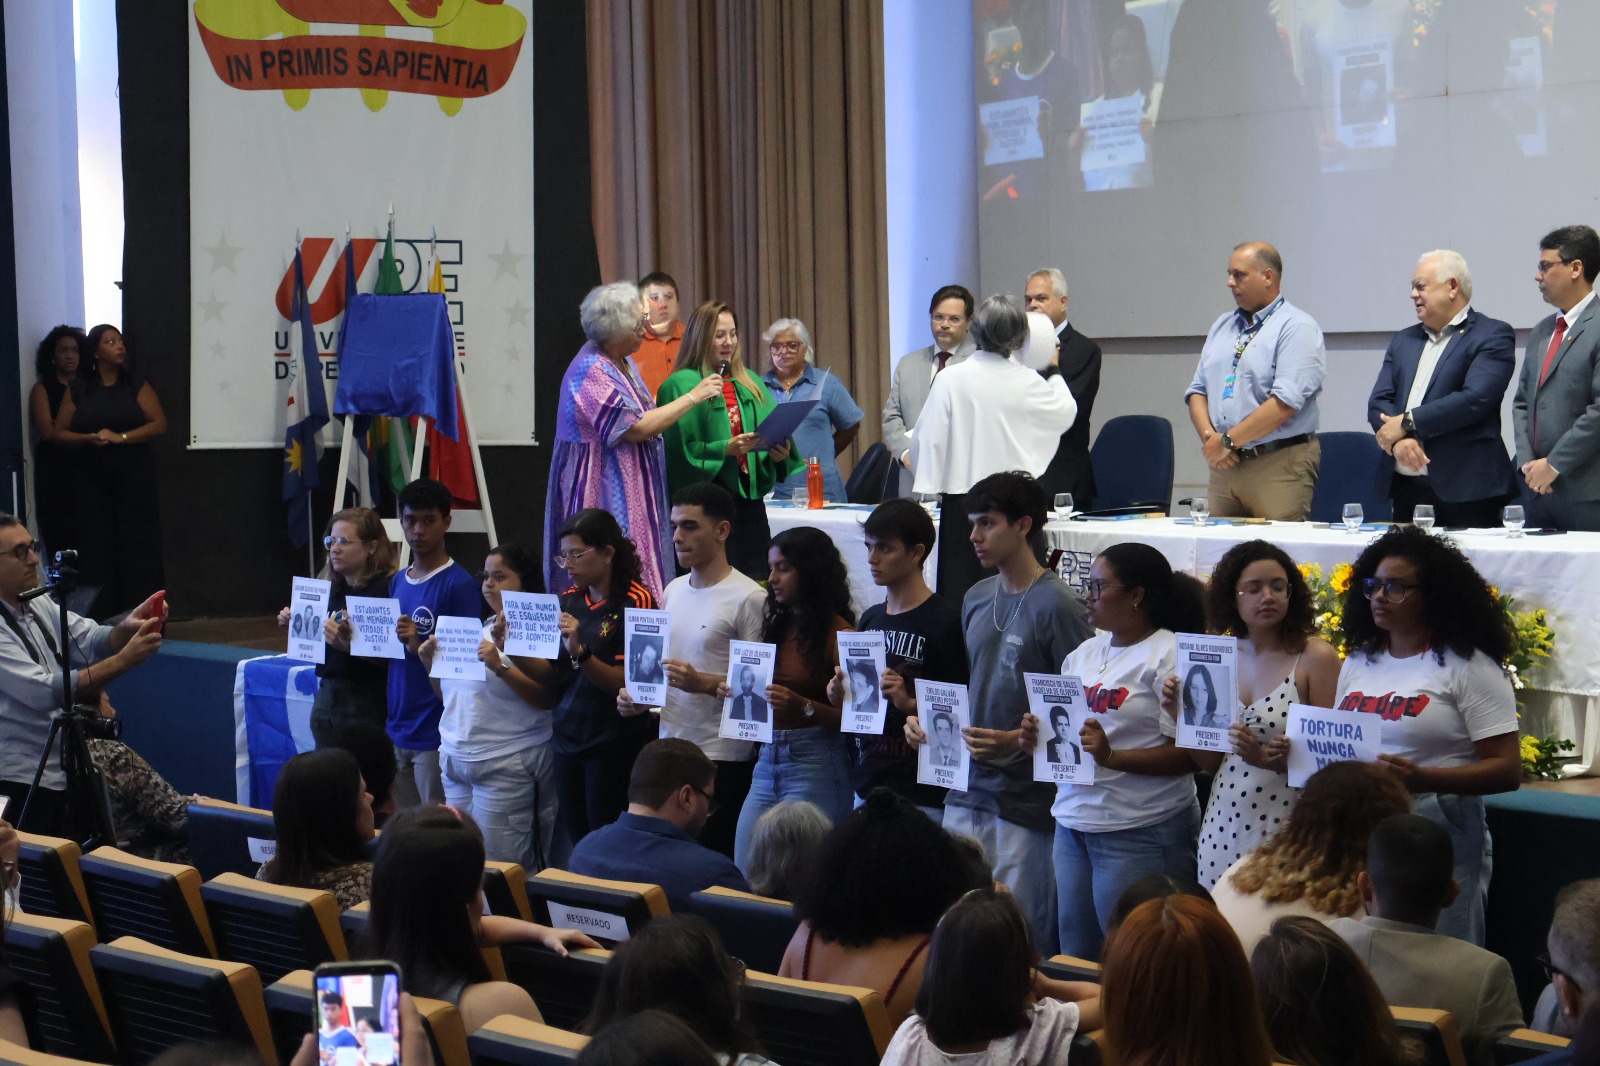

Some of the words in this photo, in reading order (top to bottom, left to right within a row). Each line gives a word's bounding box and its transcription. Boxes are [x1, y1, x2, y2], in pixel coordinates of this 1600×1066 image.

[226, 53, 253, 83] IN
[260, 48, 350, 79] PRIMIS
[358, 48, 490, 92] SAPIENTIA
[354, 606, 390, 615] ESTUDANTES
[504, 600, 520, 610] PARA
[521, 602, 534, 611] QUE
[535, 603, 558, 612] NUNCA
[352, 614, 365, 622] POR
[508, 611, 517, 620] SE
[360, 625, 384, 634] VERDADE
[386, 626, 390, 634] E
[507, 622, 524, 632] PARA
[525, 622, 537, 632] QUE
[540, 624, 559, 633] NUNCA
[364, 634, 389, 644] JUSTIÇA!
[508, 632, 523, 640] MAIS
[1032, 679, 1056, 687] FRANCISCO
[1060, 688, 1080, 696] OLIVEIRA
[1375, 696, 1421, 717] UPE
[738, 722, 759, 731] PRESENTE!
[1300, 717, 1363, 742] TORTURA
[1195, 730, 1220, 740] PRESENTE!
[1307, 738, 1356, 759] NUNCA
[1052, 764, 1077, 774] PRESENTE!
[566, 914, 610, 929] RESERVADO
